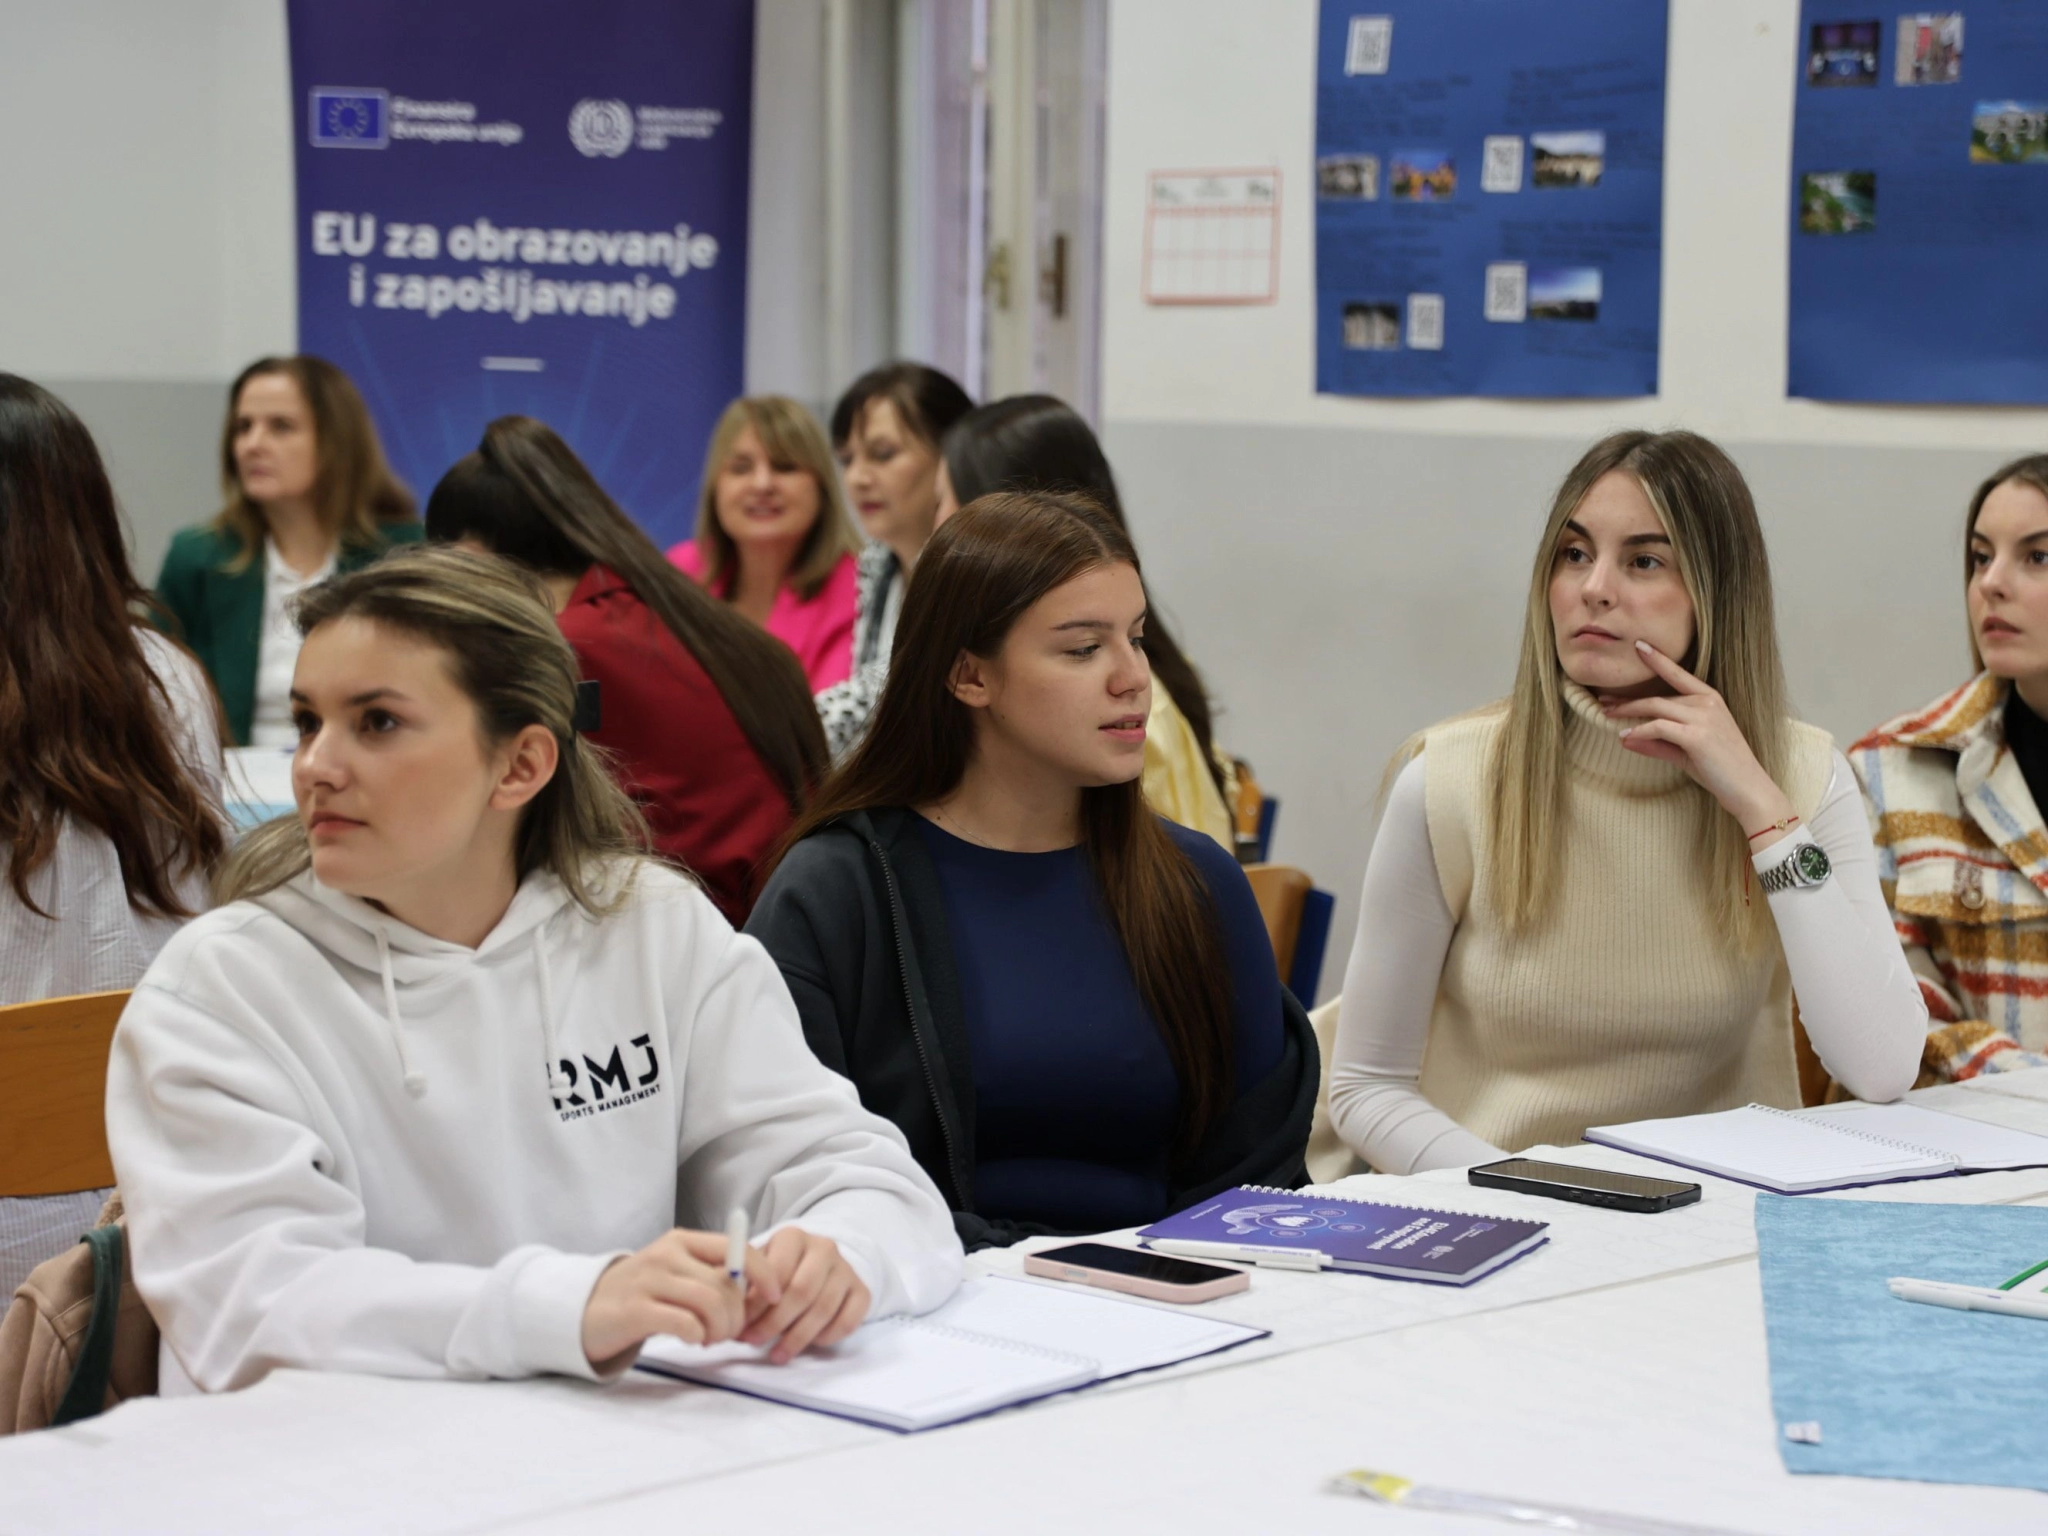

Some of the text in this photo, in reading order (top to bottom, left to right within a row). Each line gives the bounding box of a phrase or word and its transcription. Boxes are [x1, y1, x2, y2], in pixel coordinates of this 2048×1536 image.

[312, 210, 719, 278] EU za obrazovanje
[348, 262, 677, 327] i zapošljavanje
[546, 1033, 659, 1111] RMJ
[560, 1084, 661, 1122] SPORTS MANAGEMENT
